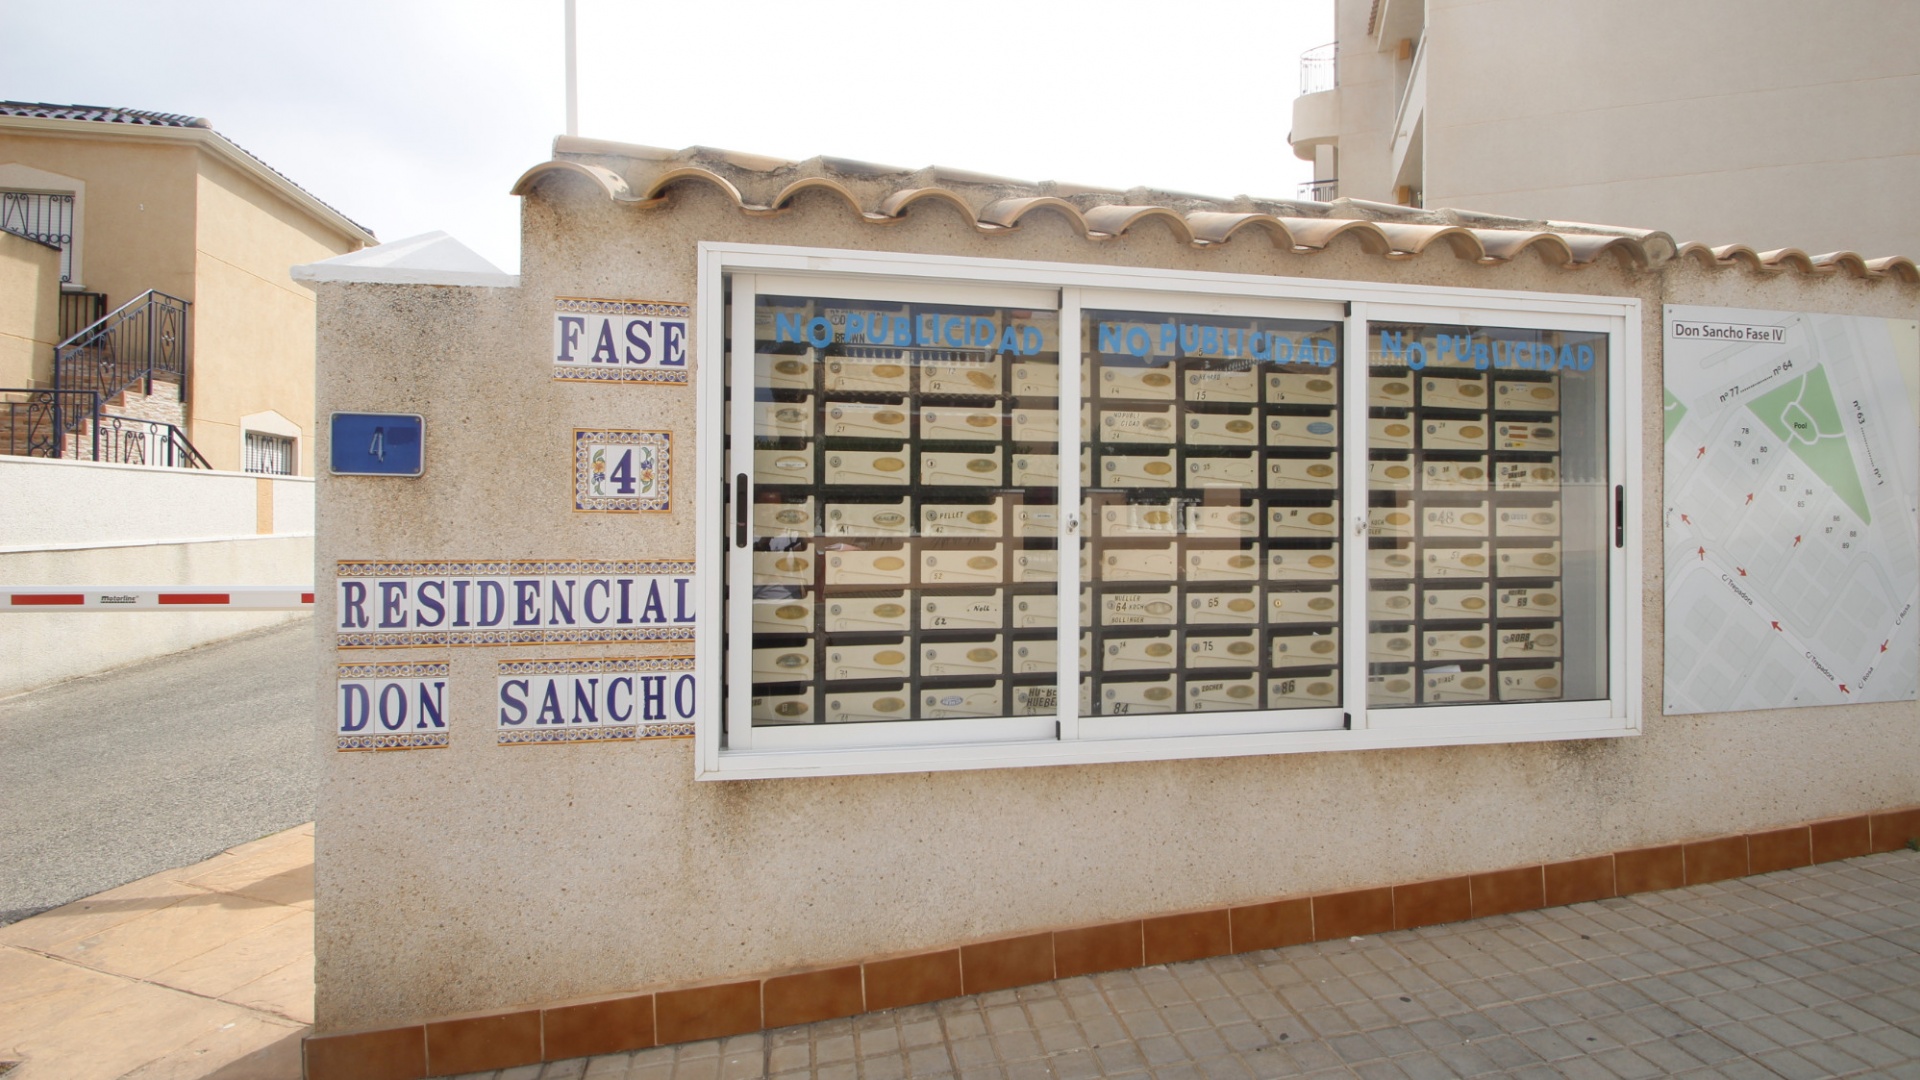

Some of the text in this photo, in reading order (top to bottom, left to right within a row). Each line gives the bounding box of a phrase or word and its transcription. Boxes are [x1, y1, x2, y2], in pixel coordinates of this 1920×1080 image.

[557, 315, 686, 366] FASE
[775, 312, 1043, 357] NO PUBLICIDAD
[835, 333, 865, 344] BRWN
[1675, 323, 1783, 341] Don Sancho Fase IV
[1098, 322, 1337, 368] NO PUBLICIDAD
[1380, 330, 1595, 372] NO PUBLICIDAD
[1728, 386, 1740, 398] 77
[1781, 360, 1793, 372] 64
[1196, 391, 1206, 400] 15
[1794, 421, 1808, 430] Pool
[609, 448, 637, 495] 4
[341, 578, 695, 628] RESIDENCIAL
[1116, 602, 1127, 612] 64
[1208, 597, 1219, 608] 65
[934, 617, 947, 626] 62
[1203, 641, 1214, 651] 75
[1862, 666, 1874, 683] Rosa
[1282, 680, 1295, 694] 86
[341, 673, 695, 732] DON SANCHO
[1113, 702, 1129, 715] 84
